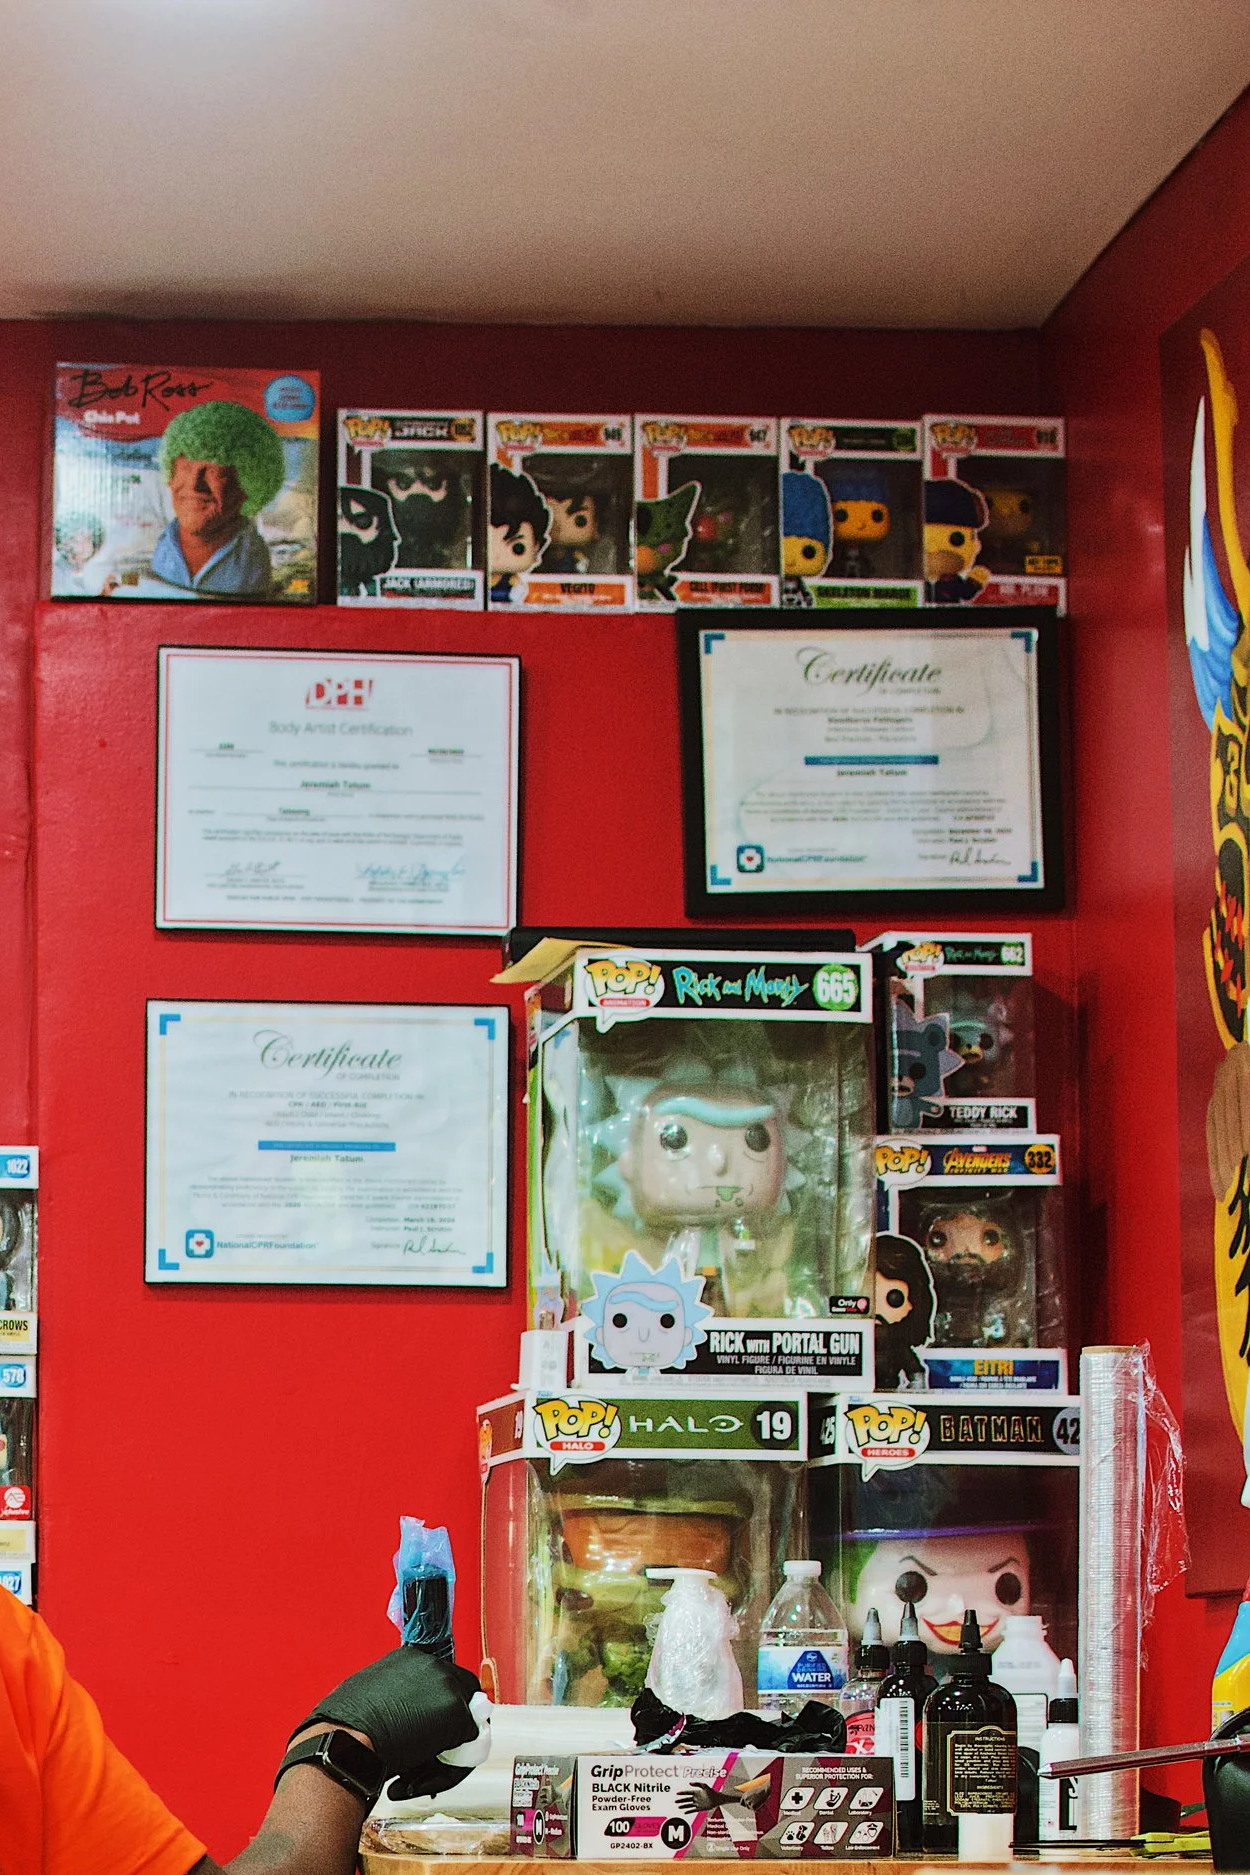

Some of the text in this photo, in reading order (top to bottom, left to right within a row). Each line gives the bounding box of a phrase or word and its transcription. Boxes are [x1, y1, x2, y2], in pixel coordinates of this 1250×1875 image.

[69, 369, 214, 411] Bob Ross
[796, 646, 942, 698] Certificate
[268, 720, 413, 736] Body Artist Certification
[586, 961, 662, 997] POP!
[673, 966, 720, 1005] Rick
[745, 966, 809, 1007] Morty
[817, 971, 857, 1003] 665
[253, 1029, 402, 1080] Certificate
[949, 1106, 1018, 1119] TEDDY RICK
[875, 1146, 1053, 1175] POP! AVENGERS 332
[837, 1298, 857, 1309] Only
[710, 1331, 745, 1353] RICK
[772, 1332, 827, 1354] PORTAL
[830, 1333, 860, 1355] GUN
[717, 1355, 740, 1365] VINYL
[741, 1355, 770, 1365] FIGURE
[816, 1356, 827, 1366] EN
[755, 1365, 784, 1375] FIGURA
[974, 1360, 1014, 1375] EITRI
[3, 1366, 25, 1384] 578
[535, 1399, 792, 1441] POP! HALO 19
[847, 1406, 1044, 1444] POP! BATMAN
[561, 1442, 595, 1450] HALO
[866, 1448, 910, 1457] HEROES
[791, 1672, 831, 1683] WATER
[682, 1766, 728, 1779] Precise
[802, 1766, 846, 1774] RECOMMENDED
[795, 1773, 823, 1781] SUPERIOR
[824, 1773, 860, 1781] PROTECTION
[592, 1782, 671, 1793] BLACK Nitrile
[592, 1795, 652, 1803] Powder-Free
[592, 1803, 651, 1811] Exam Gloves
[610, 1820, 630, 1834] 100
[668, 1825, 685, 1842] M
